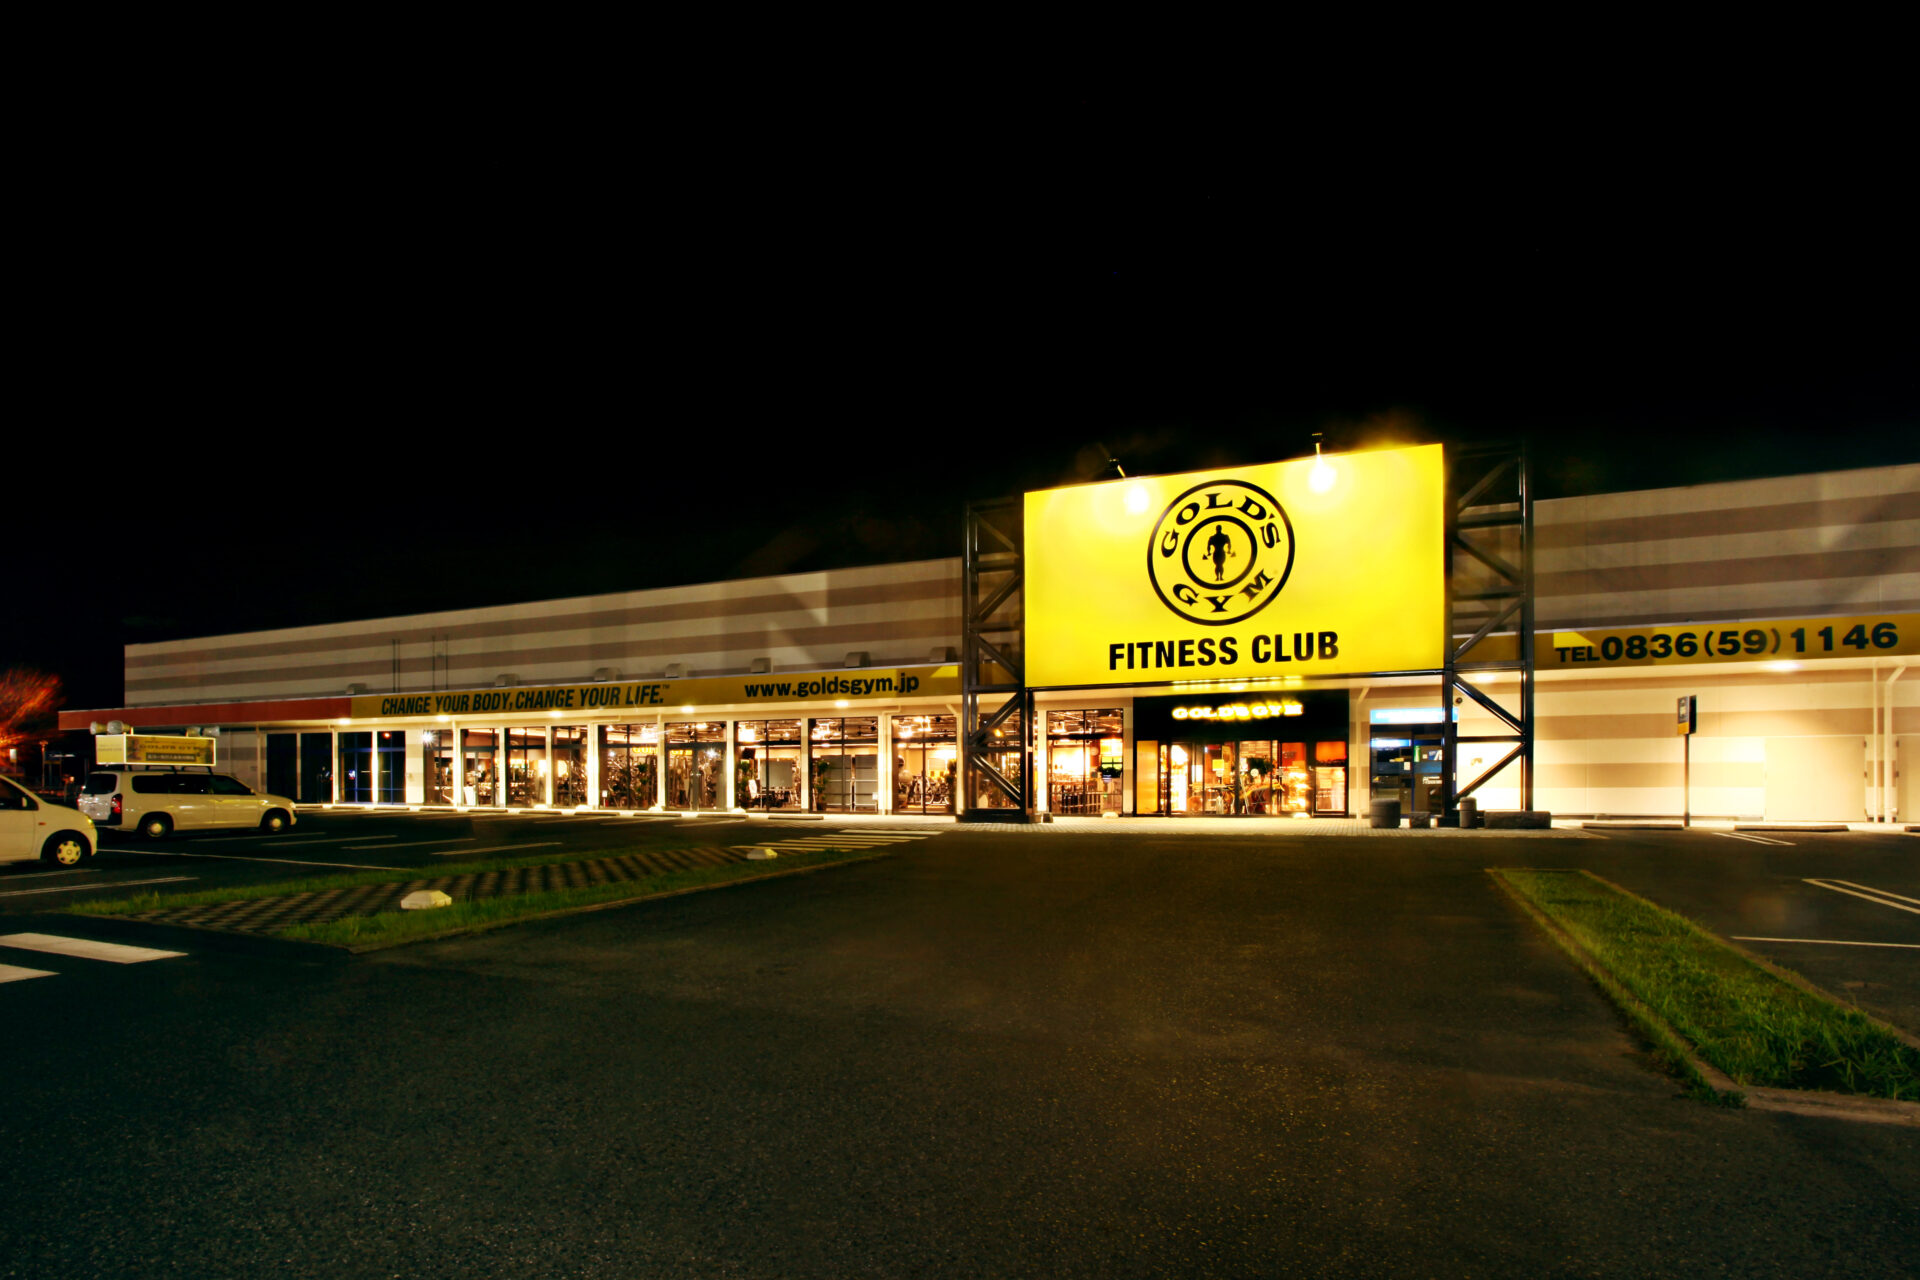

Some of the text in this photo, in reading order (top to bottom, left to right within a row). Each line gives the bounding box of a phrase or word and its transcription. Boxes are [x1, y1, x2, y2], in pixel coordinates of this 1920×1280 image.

[1161, 493, 1281, 558] GOLD'S
[1172, 569, 1274, 613] GYM
[1109, 631, 1339, 670] FITNESS CLUB
[1555, 622, 1899, 663] TEL 0836(59)1146
[381, 696, 431, 715] CHANGE
[435, 694, 470, 714] YOUR
[515, 688, 574, 709] CHANGE
[579, 686, 621, 706] YOUR
[744, 672, 919, 698] www.goldsgym.jp
